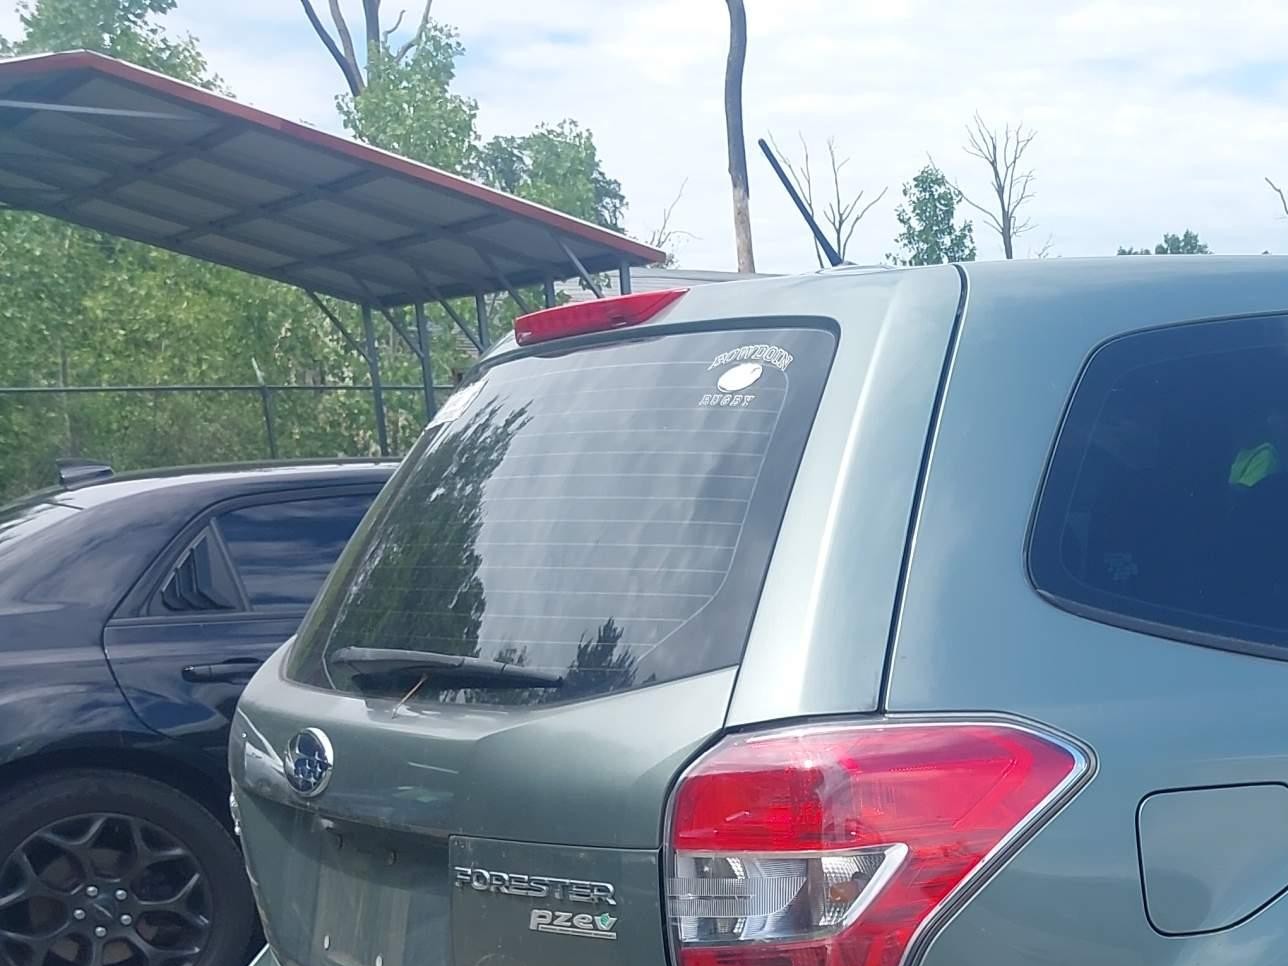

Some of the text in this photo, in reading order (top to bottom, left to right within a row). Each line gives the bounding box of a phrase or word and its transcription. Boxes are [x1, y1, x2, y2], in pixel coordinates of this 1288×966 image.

[706, 344, 793, 371] BOWDOIN
[699, 394, 756, 407] RUGBY
[454, 866, 617, 905] FORESTER
